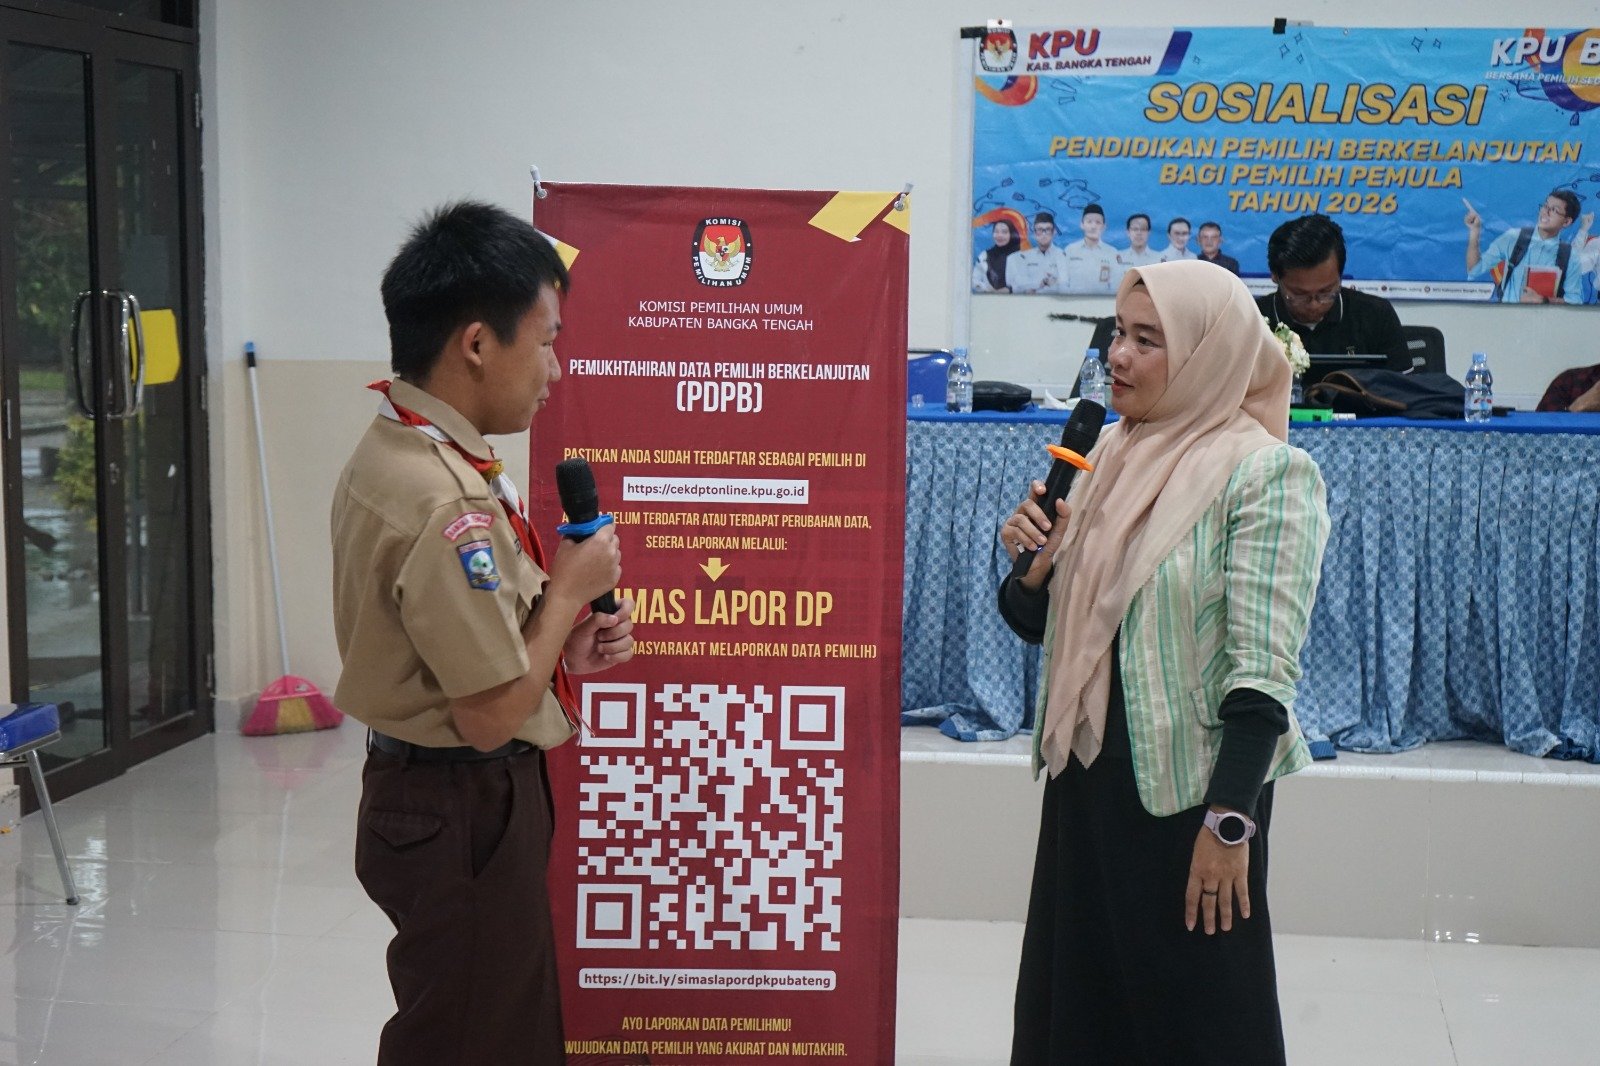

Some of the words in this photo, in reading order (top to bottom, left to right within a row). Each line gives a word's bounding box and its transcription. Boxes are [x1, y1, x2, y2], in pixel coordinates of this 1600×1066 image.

[1028, 28, 1100, 60] KPU
[1490, 36, 1567, 67] KPU
[1026, 62, 1053, 72] KAB.
[1055, 59, 1101, 71] BANGKA
[1105, 55, 1152, 68] TENGAH
[1484, 71, 1535, 81] BERSAMA
[1537, 73, 1579, 85] PEMILIH
[1143, 82, 1488, 126] SOSIALISASI
[1049, 136, 1216, 159] PENDIDIKAN
[1221, 137, 1334, 161] PEMILIH
[1338, 139, 1582, 163] BERKELANJUTAN
[1159, 163, 1226, 186] BAGI
[1230, 164, 1344, 187] PEMILIH
[1348, 165, 1463, 189] PEMULA
[1228, 190, 1321, 213] TAHUN
[1325, 192, 1398, 214] 2026
[705, 218, 742, 227] KOMISI
[692, 256, 733, 287] PEMILIHAN
[639, 300, 686, 313] KOMISI
[690, 301, 760, 314] PEMILIHAN
[764, 303, 803, 315] UMUM
[628, 316, 703, 329] KABUPATEN
[707, 317, 758, 330] BANGKA
[761, 318, 813, 331] TENGAH
[569, 358, 676, 377] PEMUKHTAHIRAN
[679, 361, 712, 379] DATA
[714, 362, 765, 380] PEMILIH
[767, 363, 870, 381] BERKELANJUTAN
[676, 380, 763, 413] (PDPB)
[563, 447, 618, 463] PASTIKAN
[620, 448, 651, 464] ANDA
[653, 449, 691, 465] SUDAH
[693, 450, 756, 466] TERDAFTAR
[758, 451, 805, 467] SEBAGAI
[807, 452, 853, 467] PEMILIH
[855, 453, 866, 467] DI
[626, 482, 805, 498] https://cekdptonline.kpu.go.id
[642, 511, 700, 526] TERDAFTAR
[701, 513, 727, 527] ATAU
[728, 513, 780, 527] TERDAPAT
[781, 514, 842, 528] PERUBAHAN
[645, 535, 685, 549] SEGERA
[686, 536, 740, 550] LAPORKAN
[741, 536, 788, 551] MELALUI:
[694, 589, 787, 626] LAPOR
[795, 590, 833, 627] DP
[709, 642, 788, 657] MELAPORKAN
[791, 643, 821, 658] DATA
[824, 643, 877, 659] PEMILIH)
[583, 973, 831, 988] https://bit.ly/simaslapordpkpubateng
[621, 1016, 643, 1031] AYO
[645, 1016, 700, 1031] LAPORKAN
[701, 1017, 728, 1031] DATA
[730, 1017, 792, 1032] PEMILIHMU!
[564, 1040, 621, 1055] WUJUDKAN
[623, 1040, 650, 1055] DATA
[651, 1041, 694, 1055] PEMILIH
[695, 1041, 724, 1055] YANG
[724, 1041, 767, 1056] AKURAT
[767, 1041, 790, 1056] DAN
[791, 1042, 848, 1056] MUTAKHIR.
